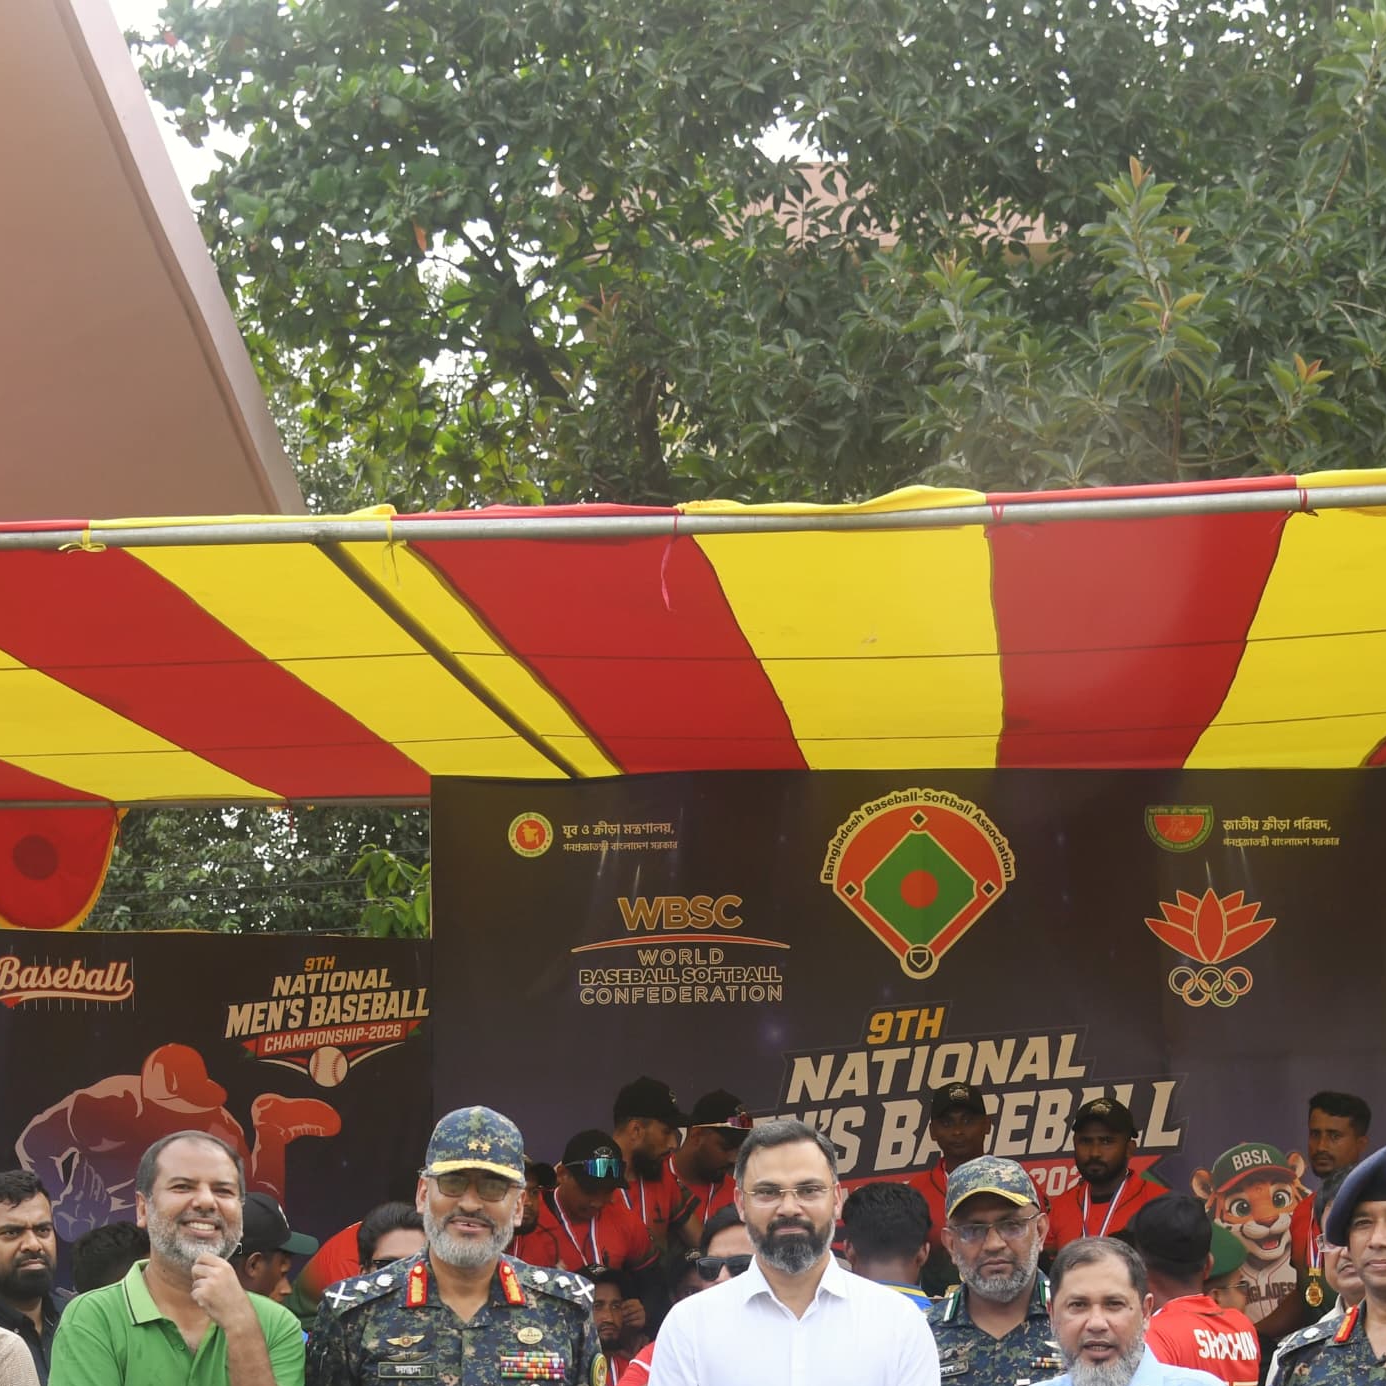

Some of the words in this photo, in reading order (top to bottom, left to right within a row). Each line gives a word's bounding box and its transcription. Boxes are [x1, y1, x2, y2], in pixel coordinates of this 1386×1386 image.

[581, 824, 590, 835] ও
[824, 813, 864, 881] Bangladesh
[865, 791, 973, 816] Baseball-Softball
[972, 811, 1013, 879] Association
[617, 895, 743, 931] WBSC
[304, 955, 336, 972] 9TH
[638, 948, 724, 967] WORLD
[272, 968, 393, 998] NATIONAL
[579, 967, 680, 986] BASEBALL
[682, 966, 783, 984] SOFTBALL
[579, 985, 783, 1005] CONFEDERATION
[224, 998, 305, 1039] MEN'S
[308, 988, 430, 1028] BASEBALL
[866, 1007, 945, 1044] 9TH
[264, 1024, 402, 1053] CHAMPIONSHIP-2026
[785, 1033, 1087, 1103] NATIONAL
[873, 1080, 1185, 1172] BEBL
[1231, 1150, 1273, 1172] BBSA
